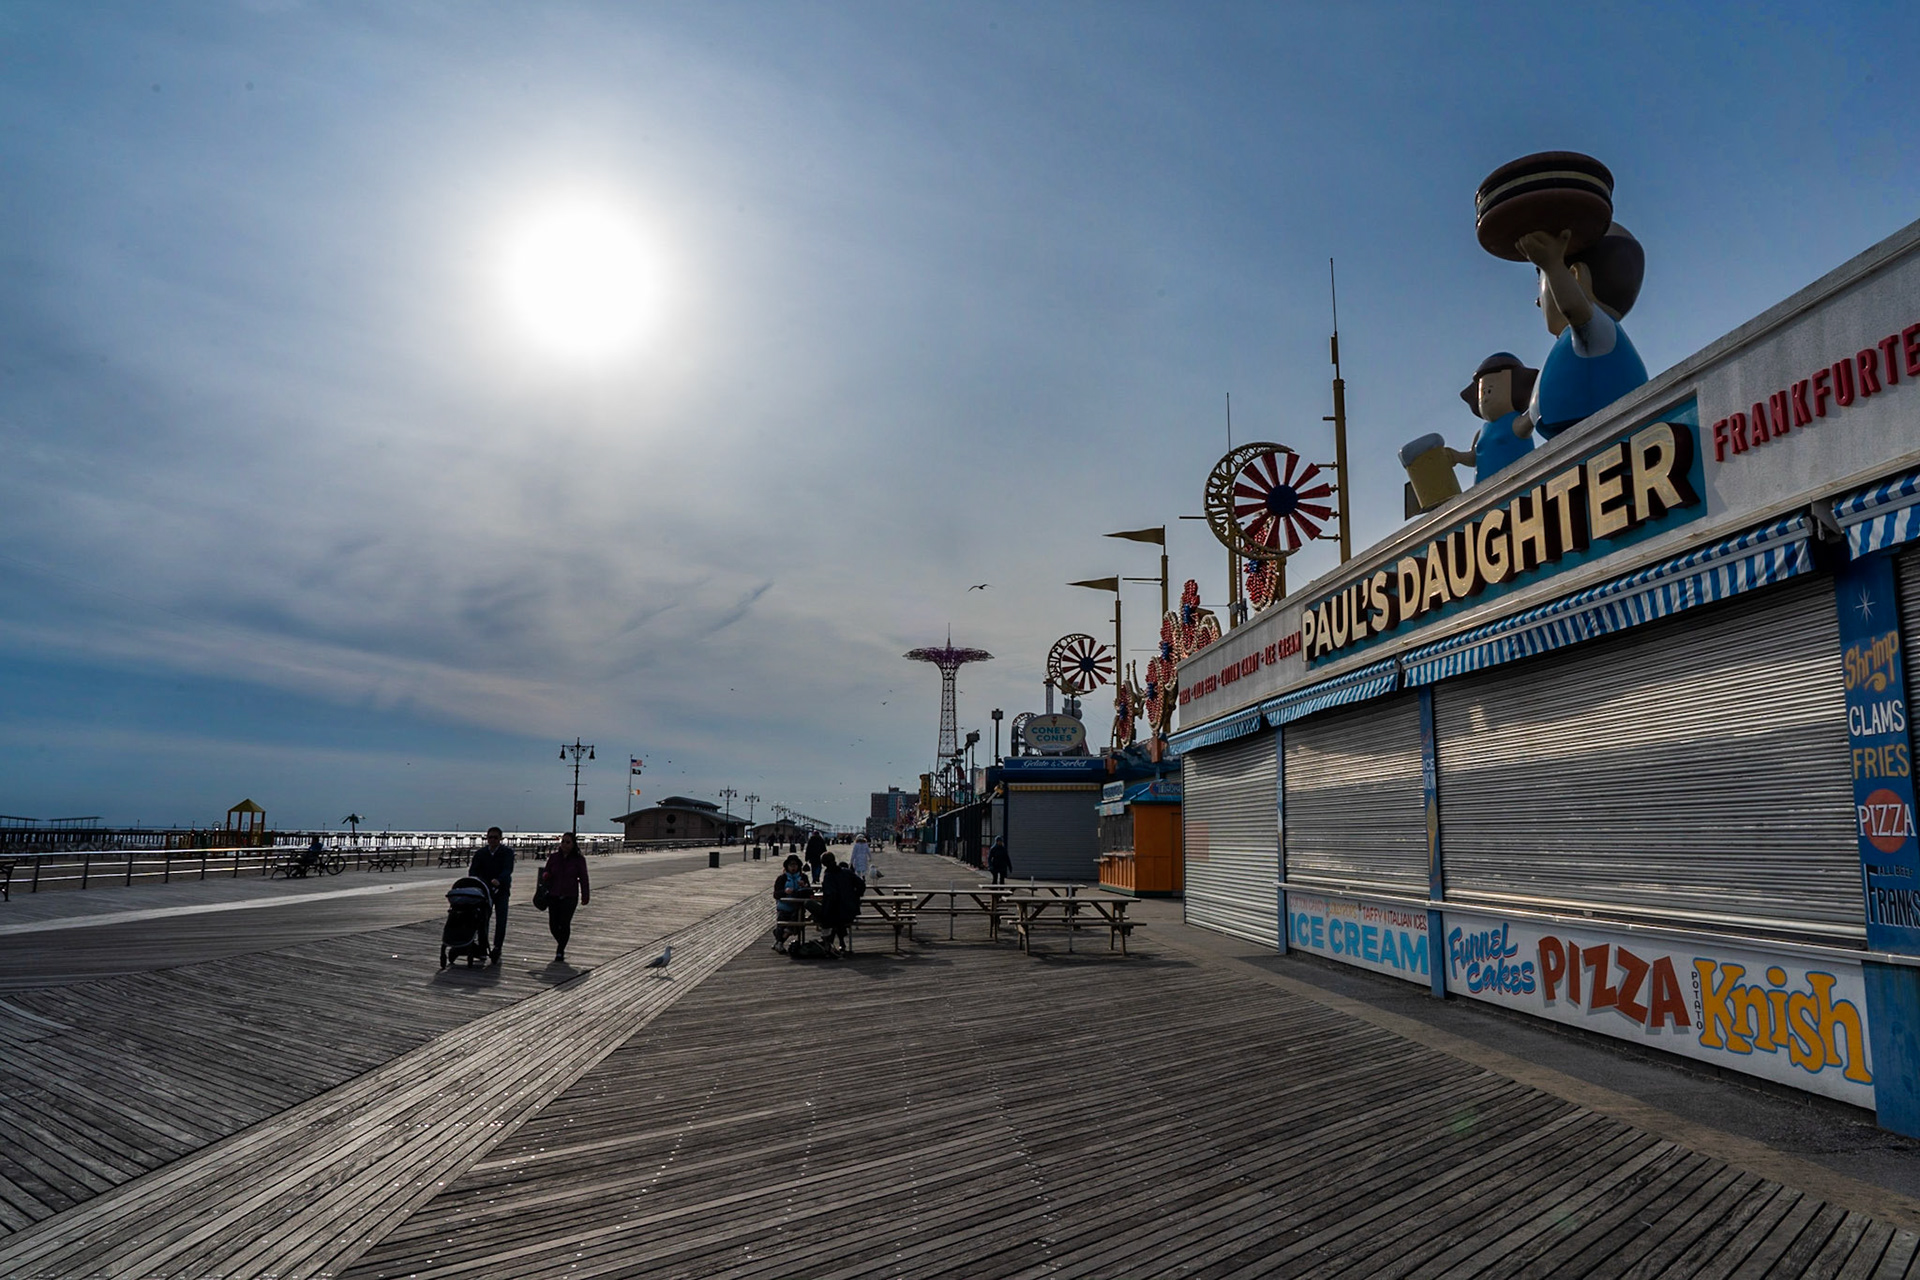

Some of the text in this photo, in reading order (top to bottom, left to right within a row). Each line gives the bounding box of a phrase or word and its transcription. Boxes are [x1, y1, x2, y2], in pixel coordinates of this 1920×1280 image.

[1301, 421, 1692, 662] PAUL'S DAUGHTER
[1844, 630, 1899, 691] Shrimp
[1031, 726, 1078, 734] CONEY'S
[1849, 699, 1906, 737] CLAMS
[1022, 760, 1049, 768] Gelato
[1057, 759, 1087, 768] Sorbet
[1852, 743, 1910, 780] FRIES
[1857, 803, 1917, 837] PIZZA
[1878, 864, 1914, 879] ALL BEEF
[1362, 905, 1383, 923] TAFFY
[1387, 910, 1413, 928] ITALIAN
[1413, 914, 1428, 931] ICES
[1289, 912, 1430, 976] ICE CREAM
[1467, 957, 1537, 996] Cakes
[1537, 935, 1692, 1032] PIZZA
[1690, 971, 1704, 1031] POTATO
[1692, 957, 1874, 1086] Knish
